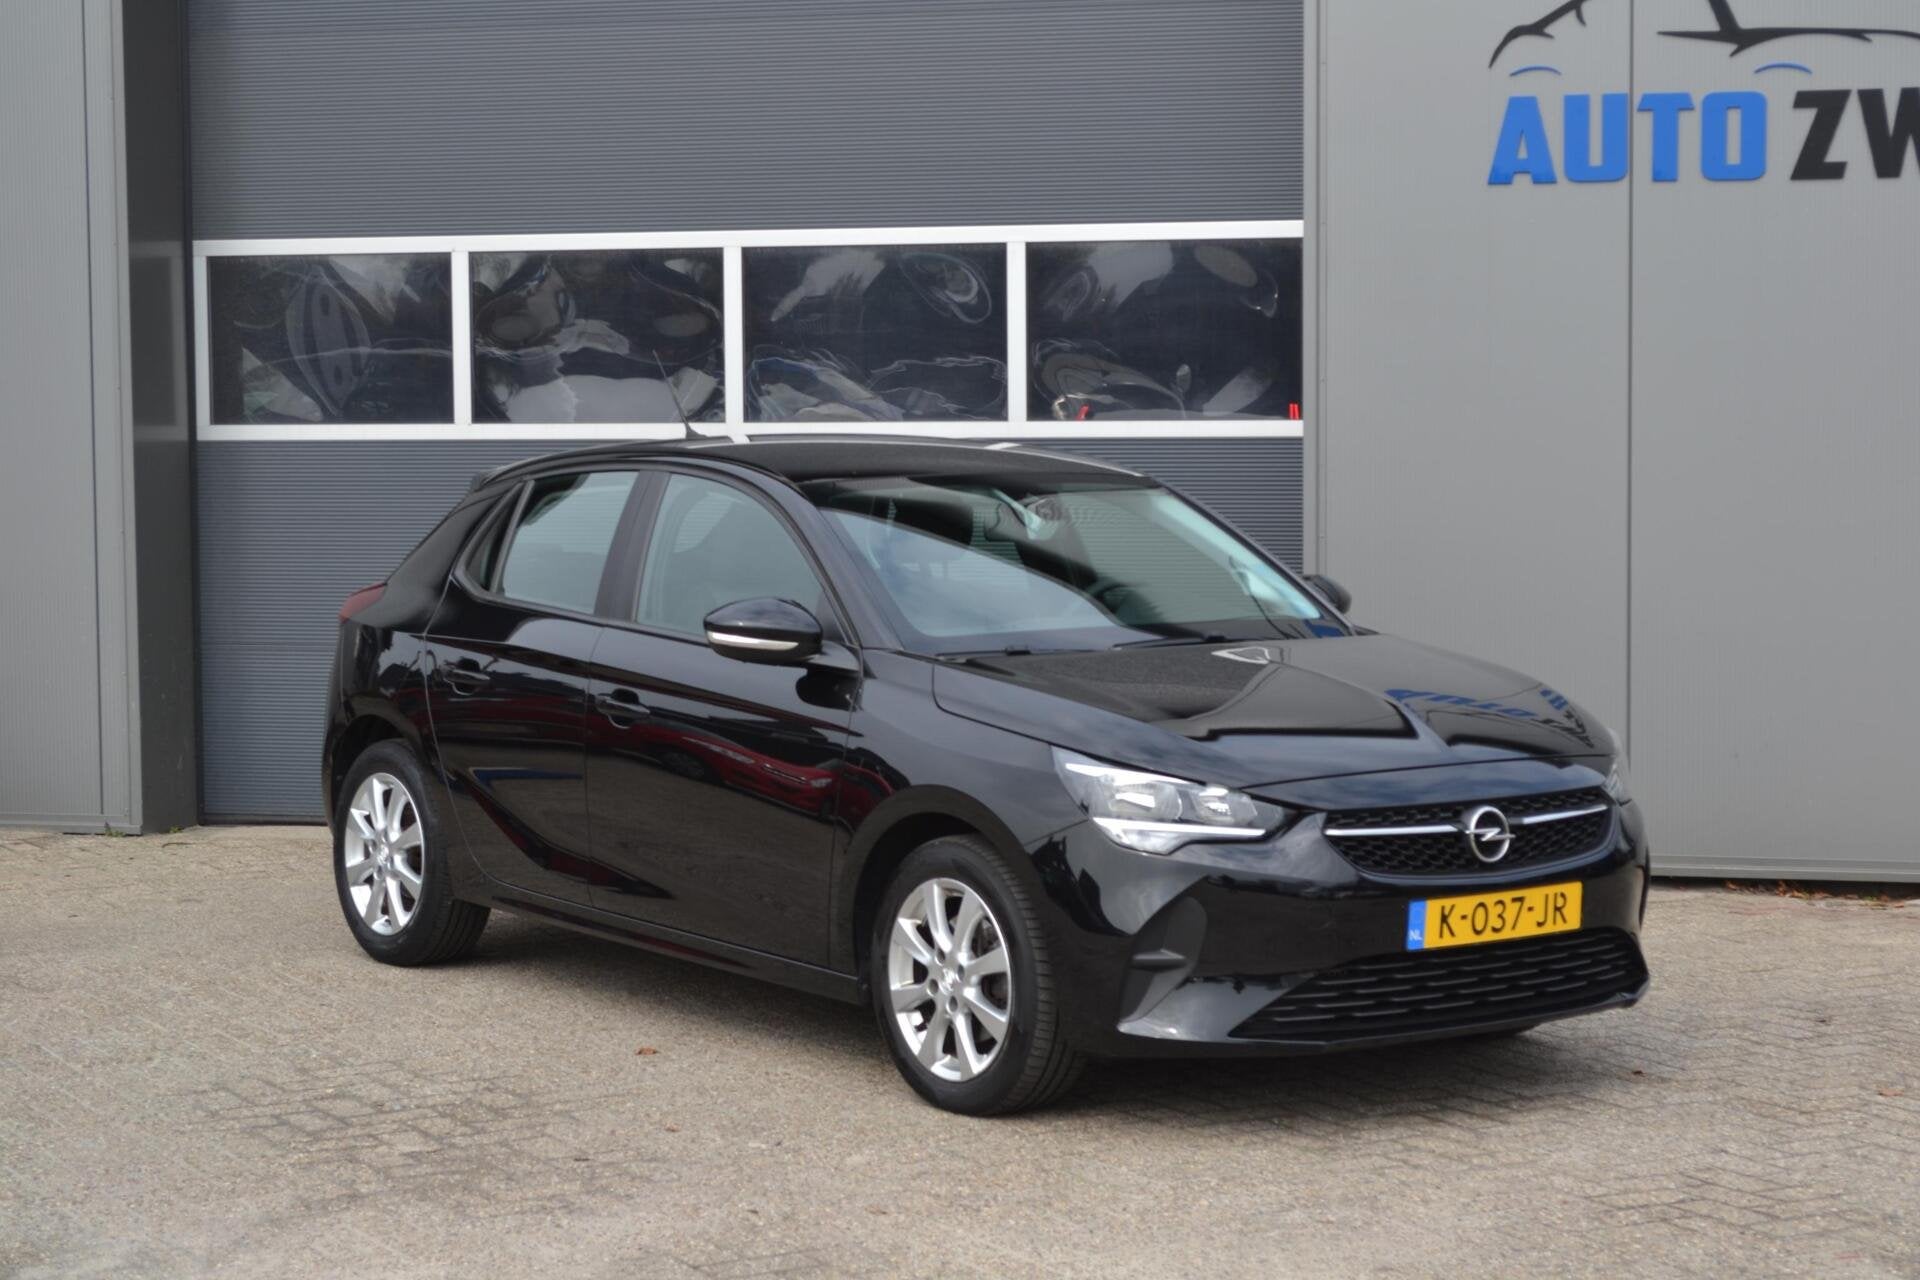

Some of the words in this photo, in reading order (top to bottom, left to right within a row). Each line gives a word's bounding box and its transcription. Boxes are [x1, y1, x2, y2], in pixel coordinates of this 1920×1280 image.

[1487, 90, 1767, 185] AUTO
[1409, 928, 1423, 941] NL
[1439, 891, 1568, 939] K-037-JR
